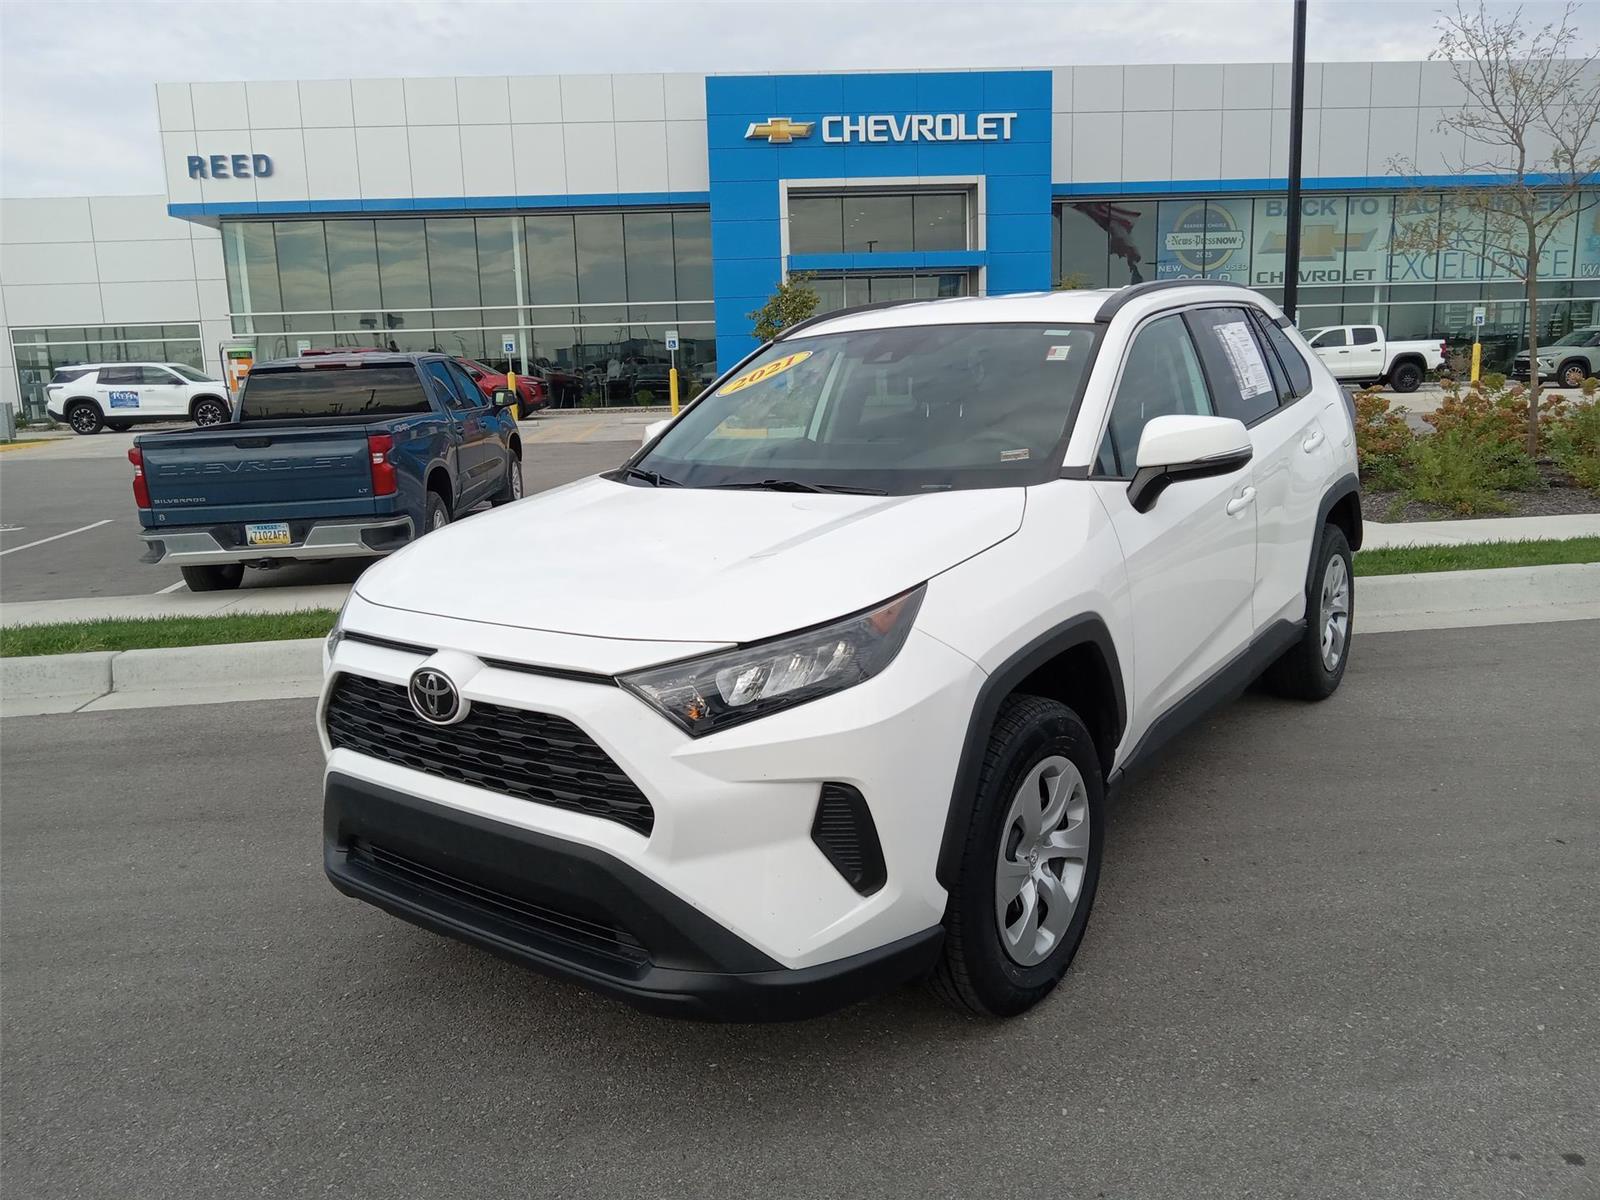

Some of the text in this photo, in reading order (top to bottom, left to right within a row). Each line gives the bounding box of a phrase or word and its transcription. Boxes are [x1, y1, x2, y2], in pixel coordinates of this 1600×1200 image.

[822, 112, 1018, 143] CHEVROLET
[187, 154, 274, 179] REED
[1266, 199, 1336, 216] BCK
[1347, 198, 1379, 215] TO
[1158, 265, 1182, 273] NEW
[1224, 264, 1248, 272] USED
[1386, 249, 1569, 280] EXCELLENCE
[1256, 269, 1377, 284] CHVROLET
[731, 356, 795, 392] 2021
[159, 455, 353, 476] CHEVROLET
